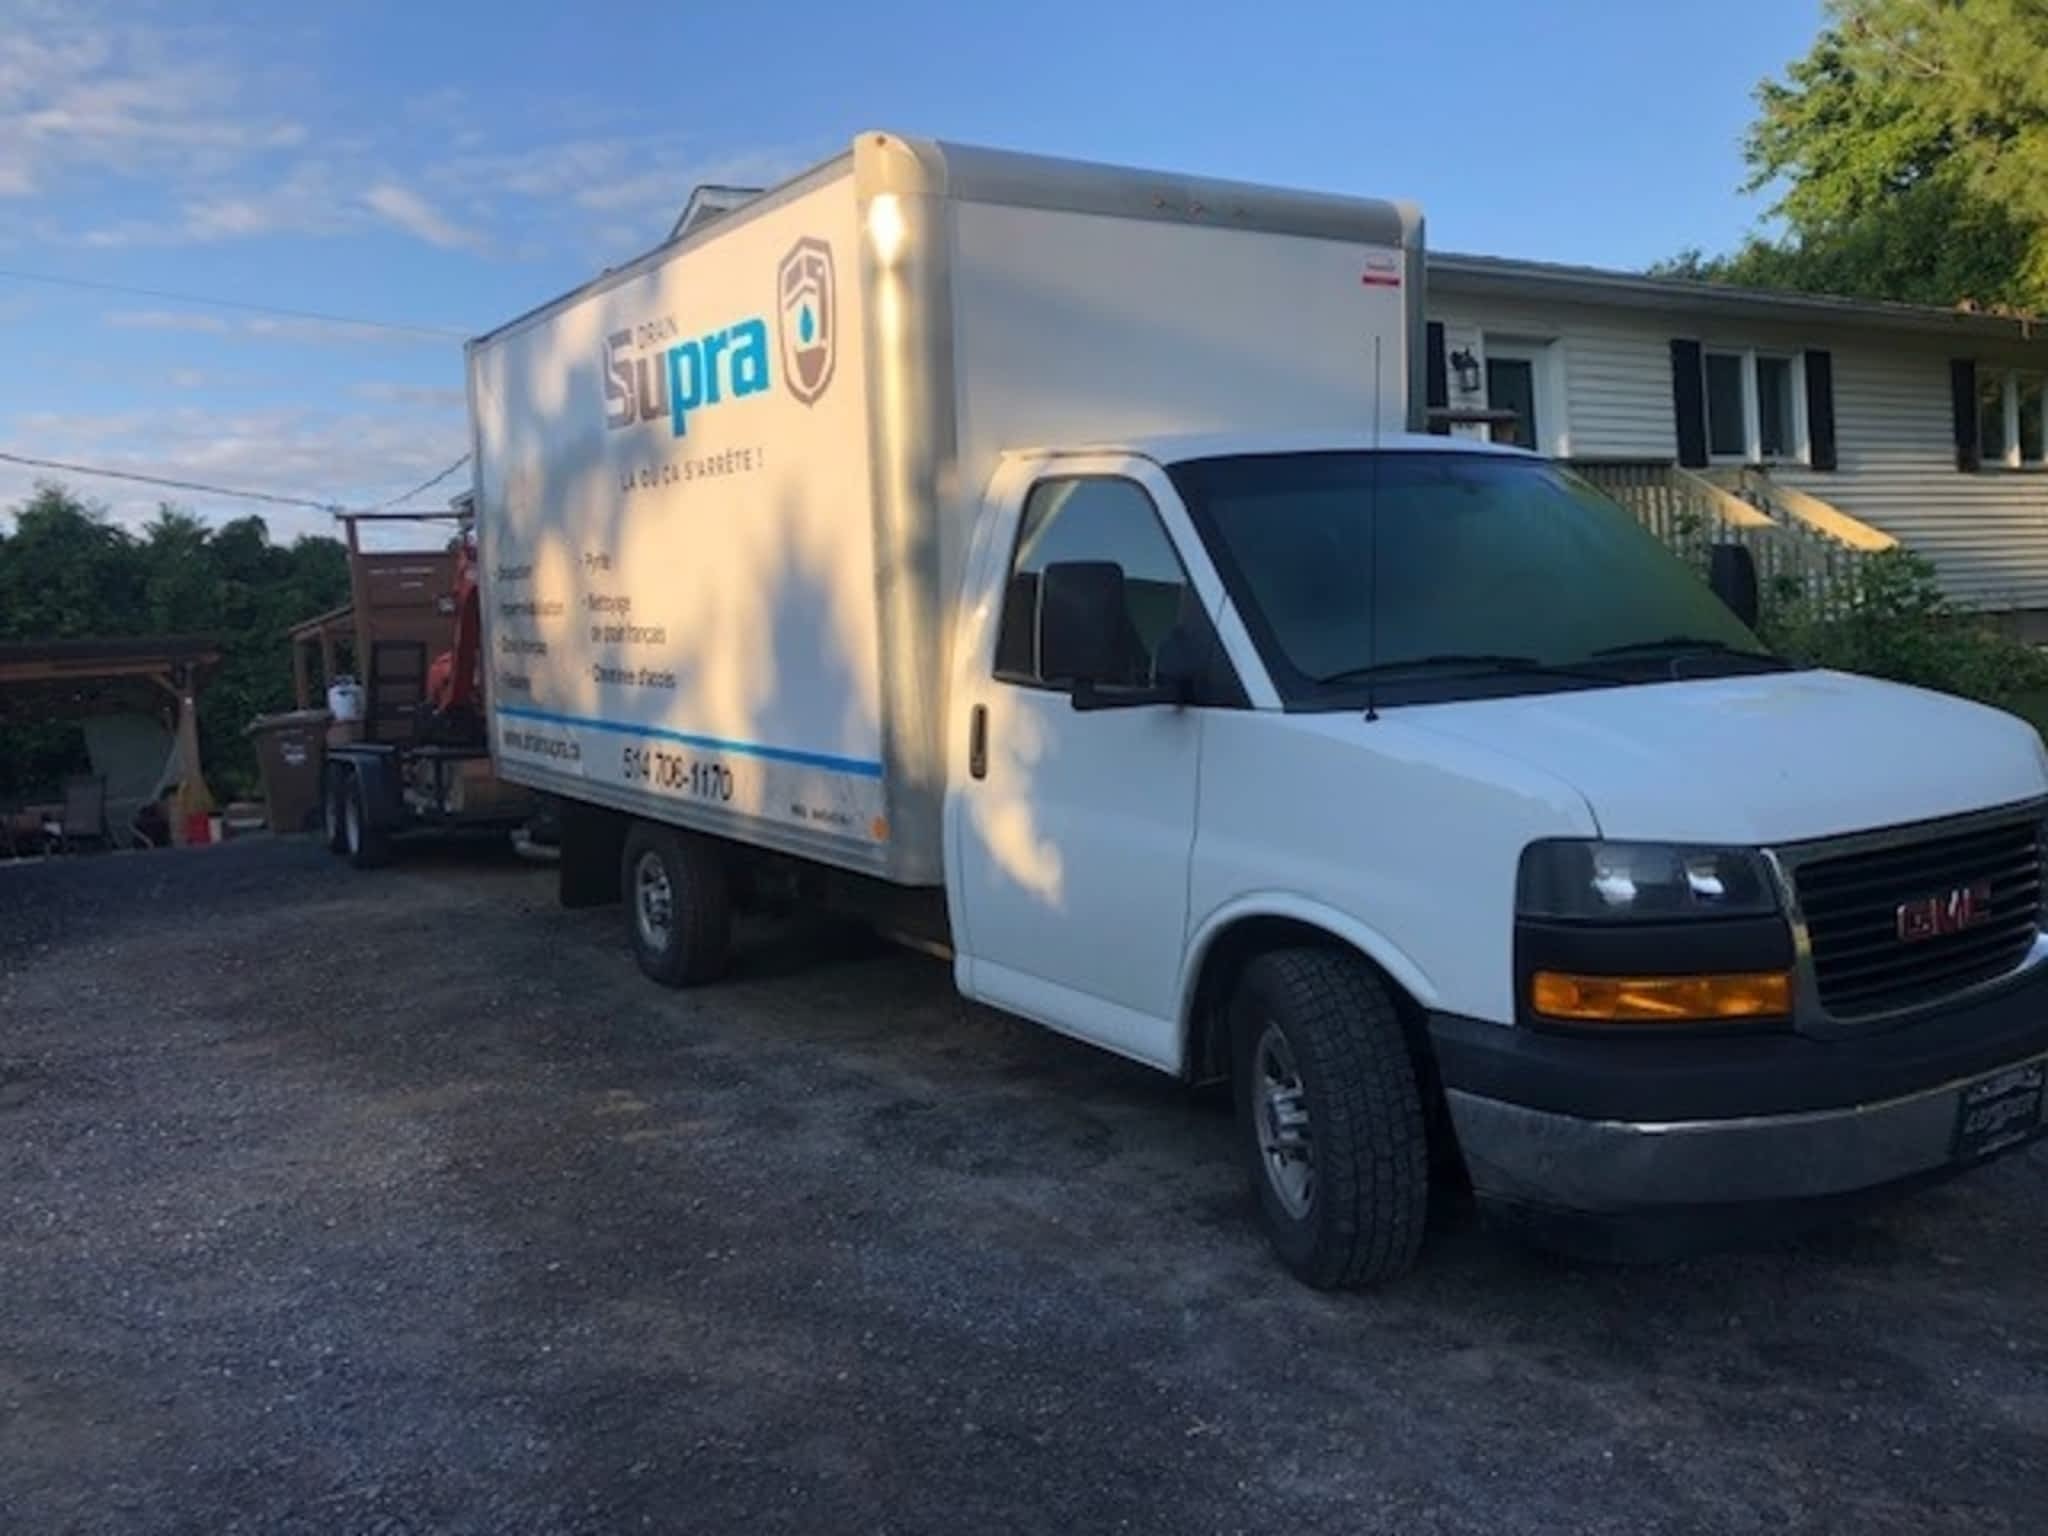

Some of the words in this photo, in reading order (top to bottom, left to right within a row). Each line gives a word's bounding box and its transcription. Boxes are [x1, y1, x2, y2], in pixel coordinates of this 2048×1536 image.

[603, 318, 770, 437] Supra
[623, 747, 652, 781] 514
[653, 753, 734, 802] 706-1170
[1897, 883, 1991, 943] GMC
